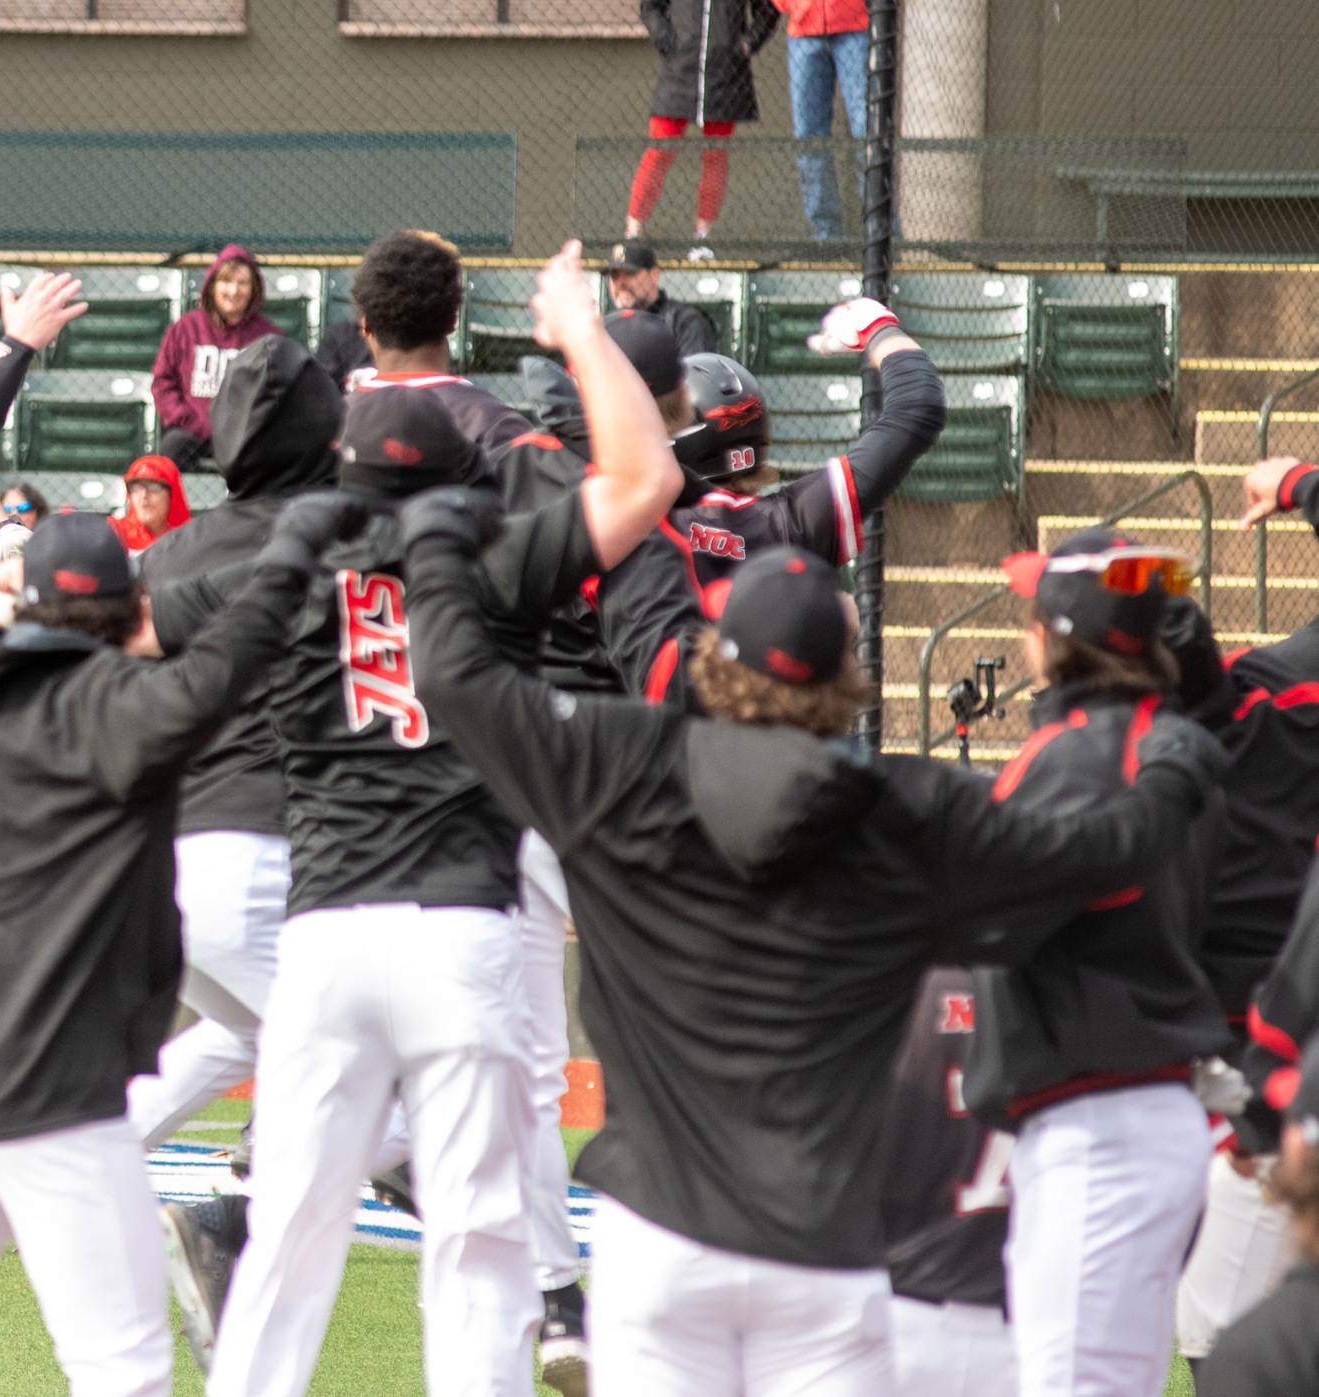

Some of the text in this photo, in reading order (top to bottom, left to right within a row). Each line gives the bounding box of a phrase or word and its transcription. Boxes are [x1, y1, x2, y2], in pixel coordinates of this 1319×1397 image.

[730, 447, 756, 471] 10
[689, 522, 746, 560] NOC
[335, 568, 430, 749] JETS
